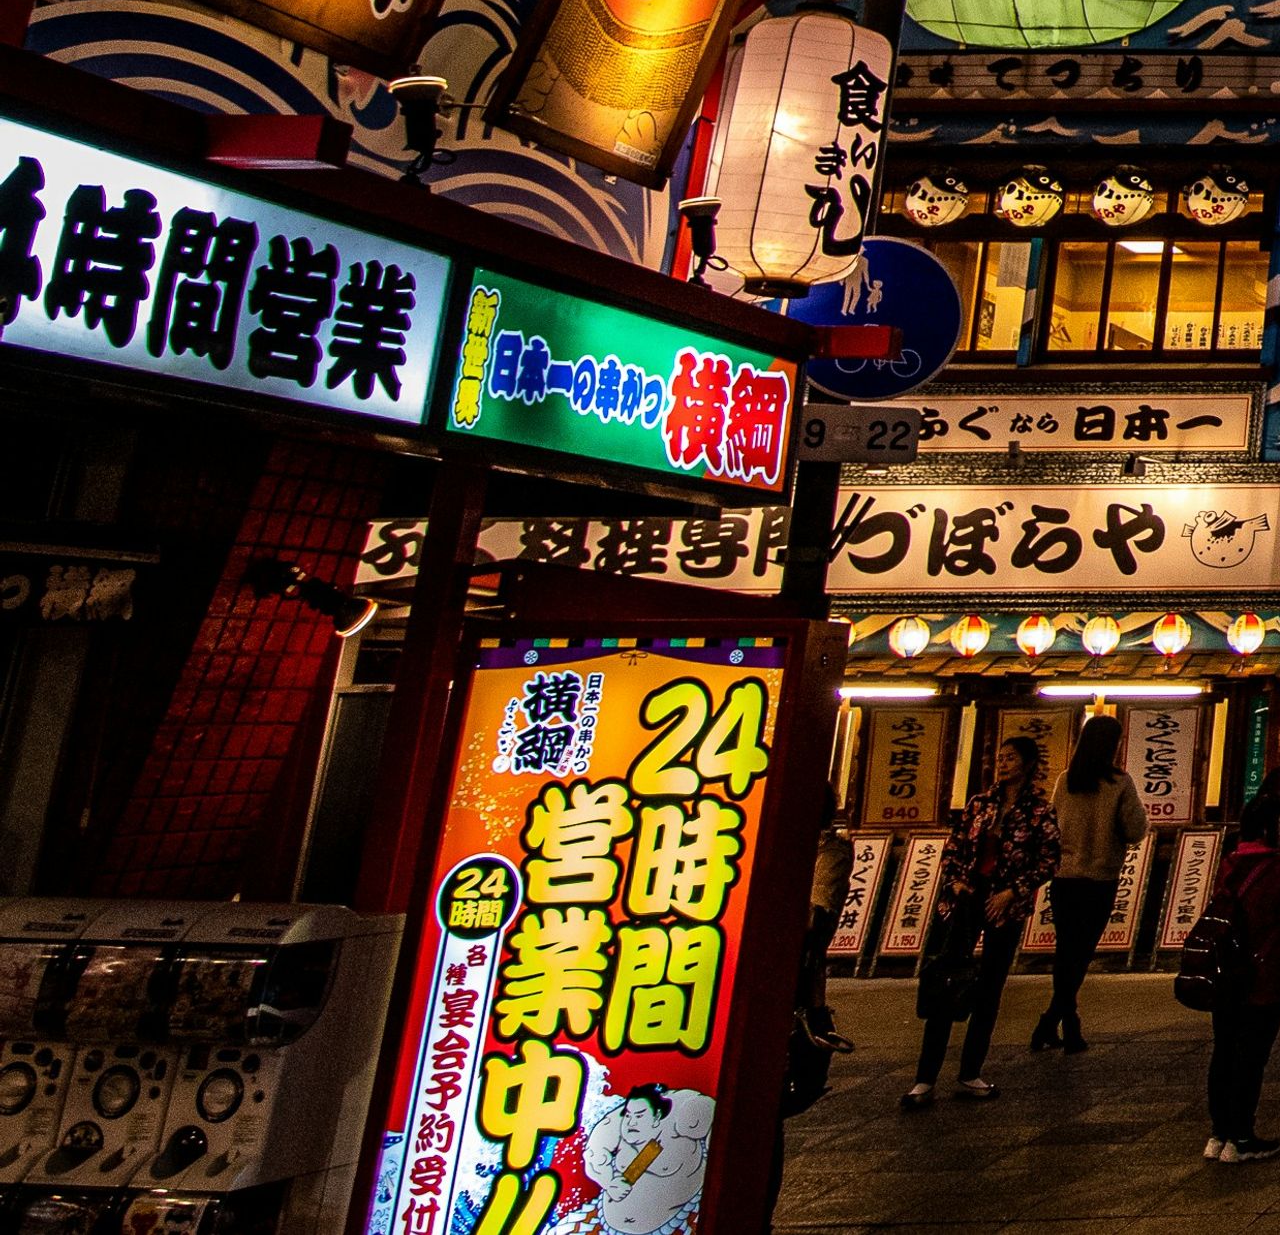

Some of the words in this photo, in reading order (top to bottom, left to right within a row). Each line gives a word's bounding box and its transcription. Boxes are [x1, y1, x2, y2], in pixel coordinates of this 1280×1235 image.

[452, 287, 500, 428] 新世界
[491, 330, 666, 428] 日本一の串かつ
[666, 349, 788, 482] 横綱
[867, 420, 912, 450] 22
[362, 508, 795, 577] ふ料理専門
[846, 501, 1166, 576] づぼらや
[516, 672, 581, 771] 横綱
[574, 674, 602, 772] 日本一の串かつ
[1143, 714, 1180, 796] ふぐにぎり
[883, 807, 918, 819] 840
[1250, 770, 1258, 782] 5
[453, 868, 508, 899] 24
[603, 679, 767, 1055] 24時間
[900, 844, 936, 929] ふぐうどん定食
[449, 899, 502, 929] 時間
